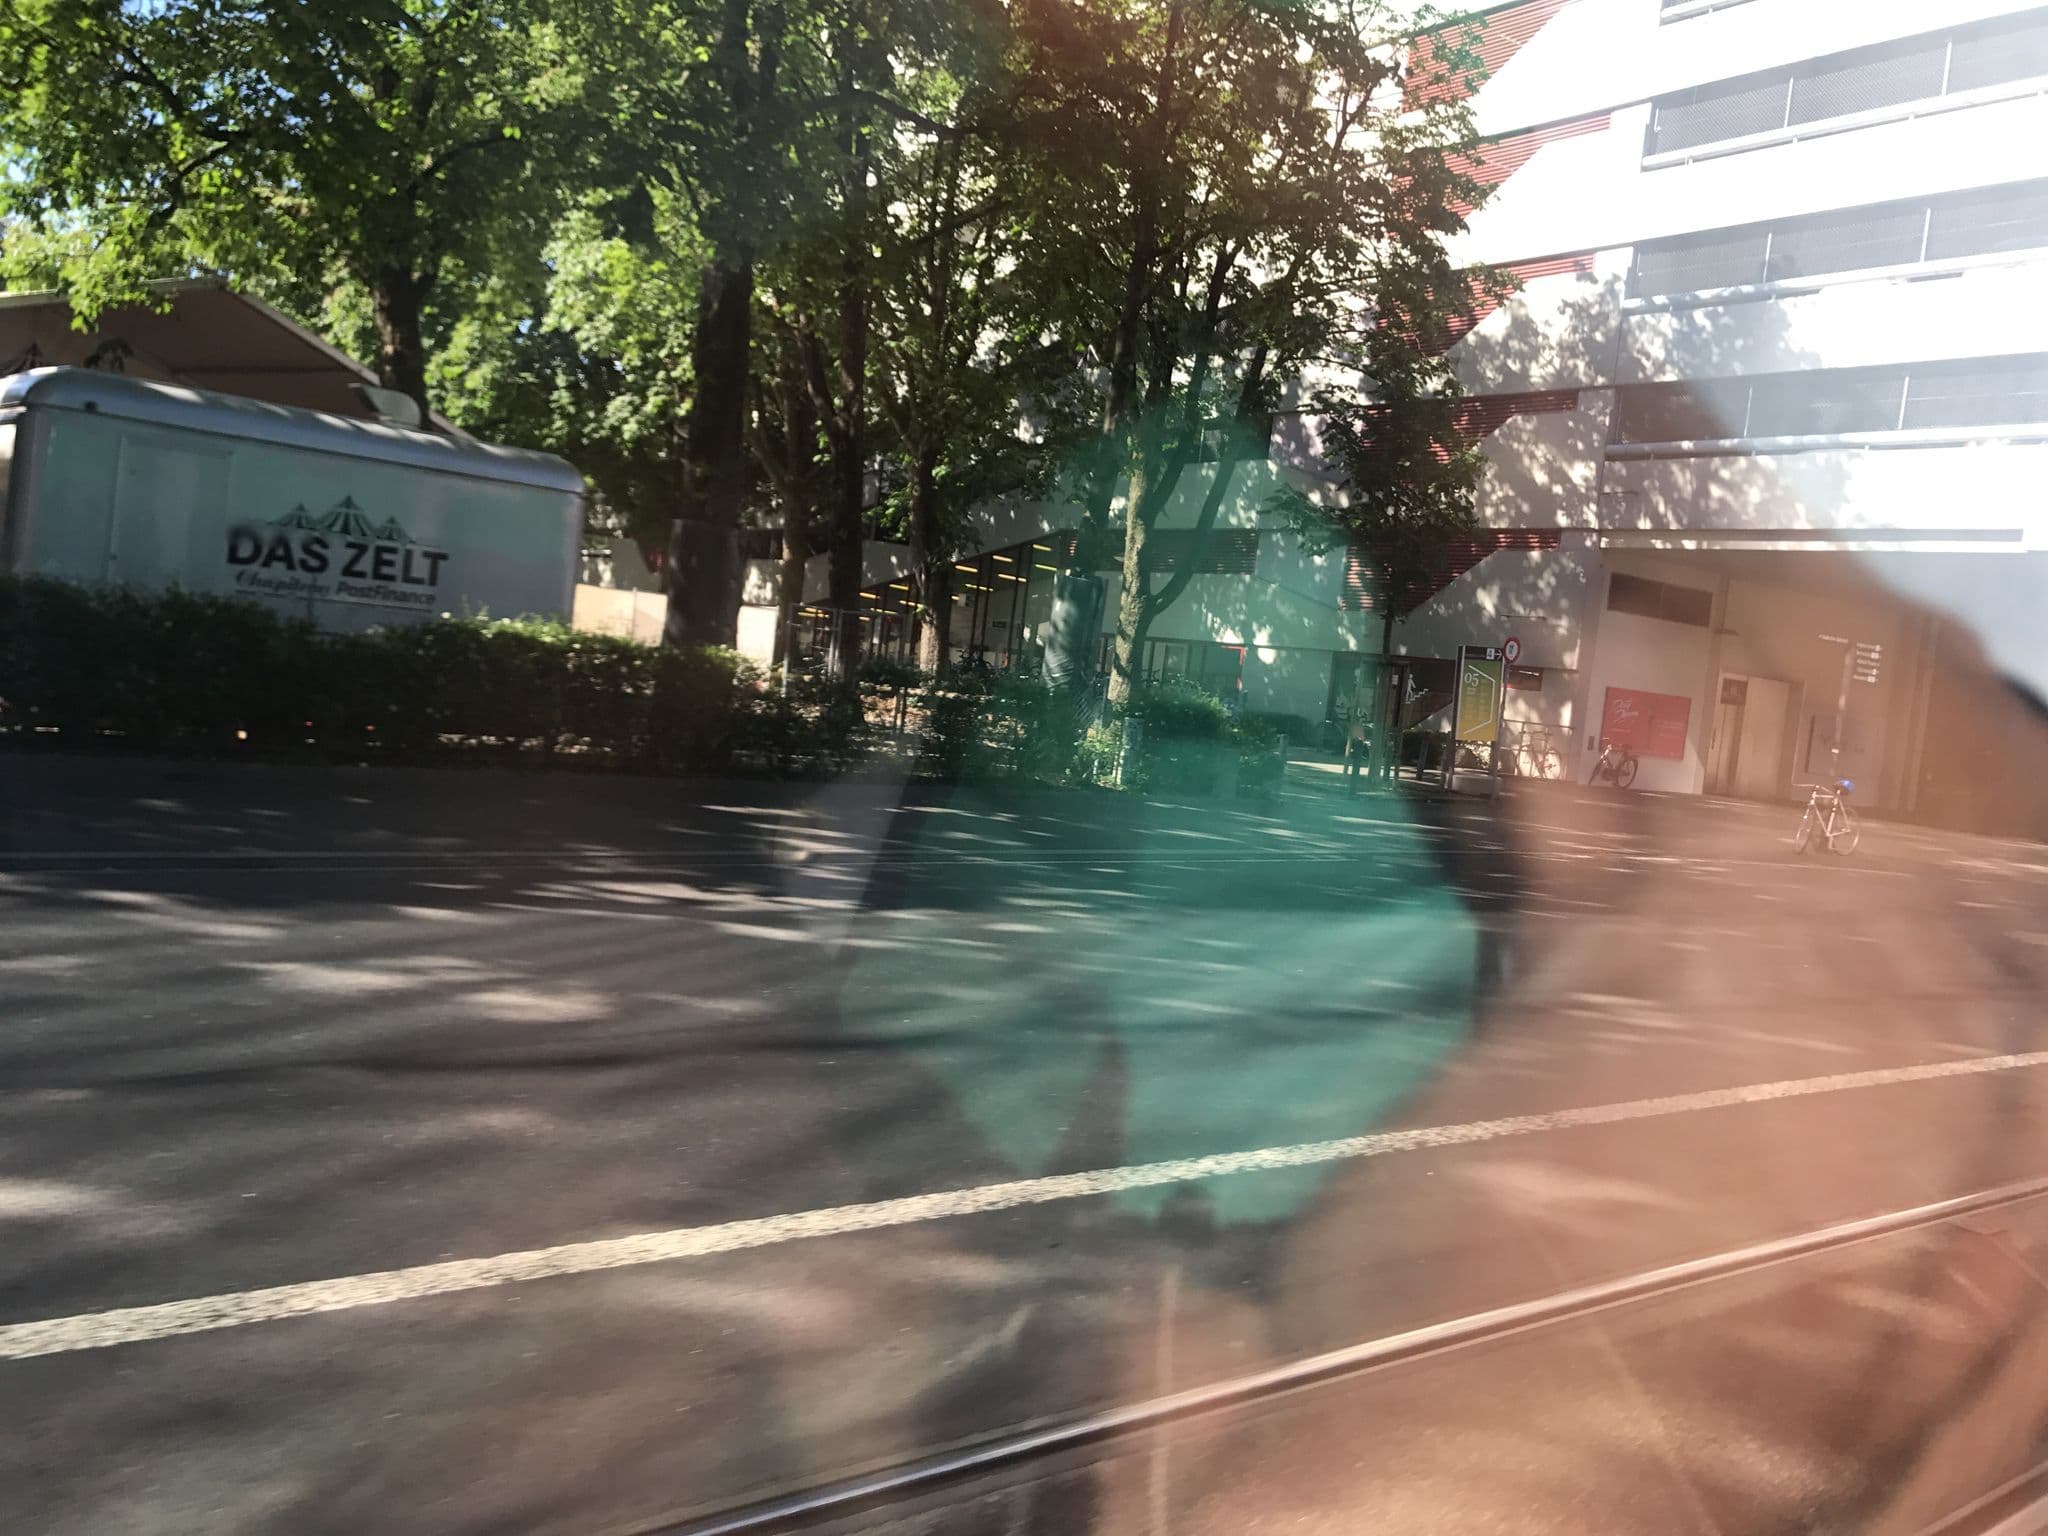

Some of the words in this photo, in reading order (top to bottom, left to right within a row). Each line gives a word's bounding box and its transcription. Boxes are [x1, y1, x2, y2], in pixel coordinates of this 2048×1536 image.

[227, 525, 329, 573] DAS
[341, 541, 449, 587] ZELT
[1464, 672, 1479, 687] 05
